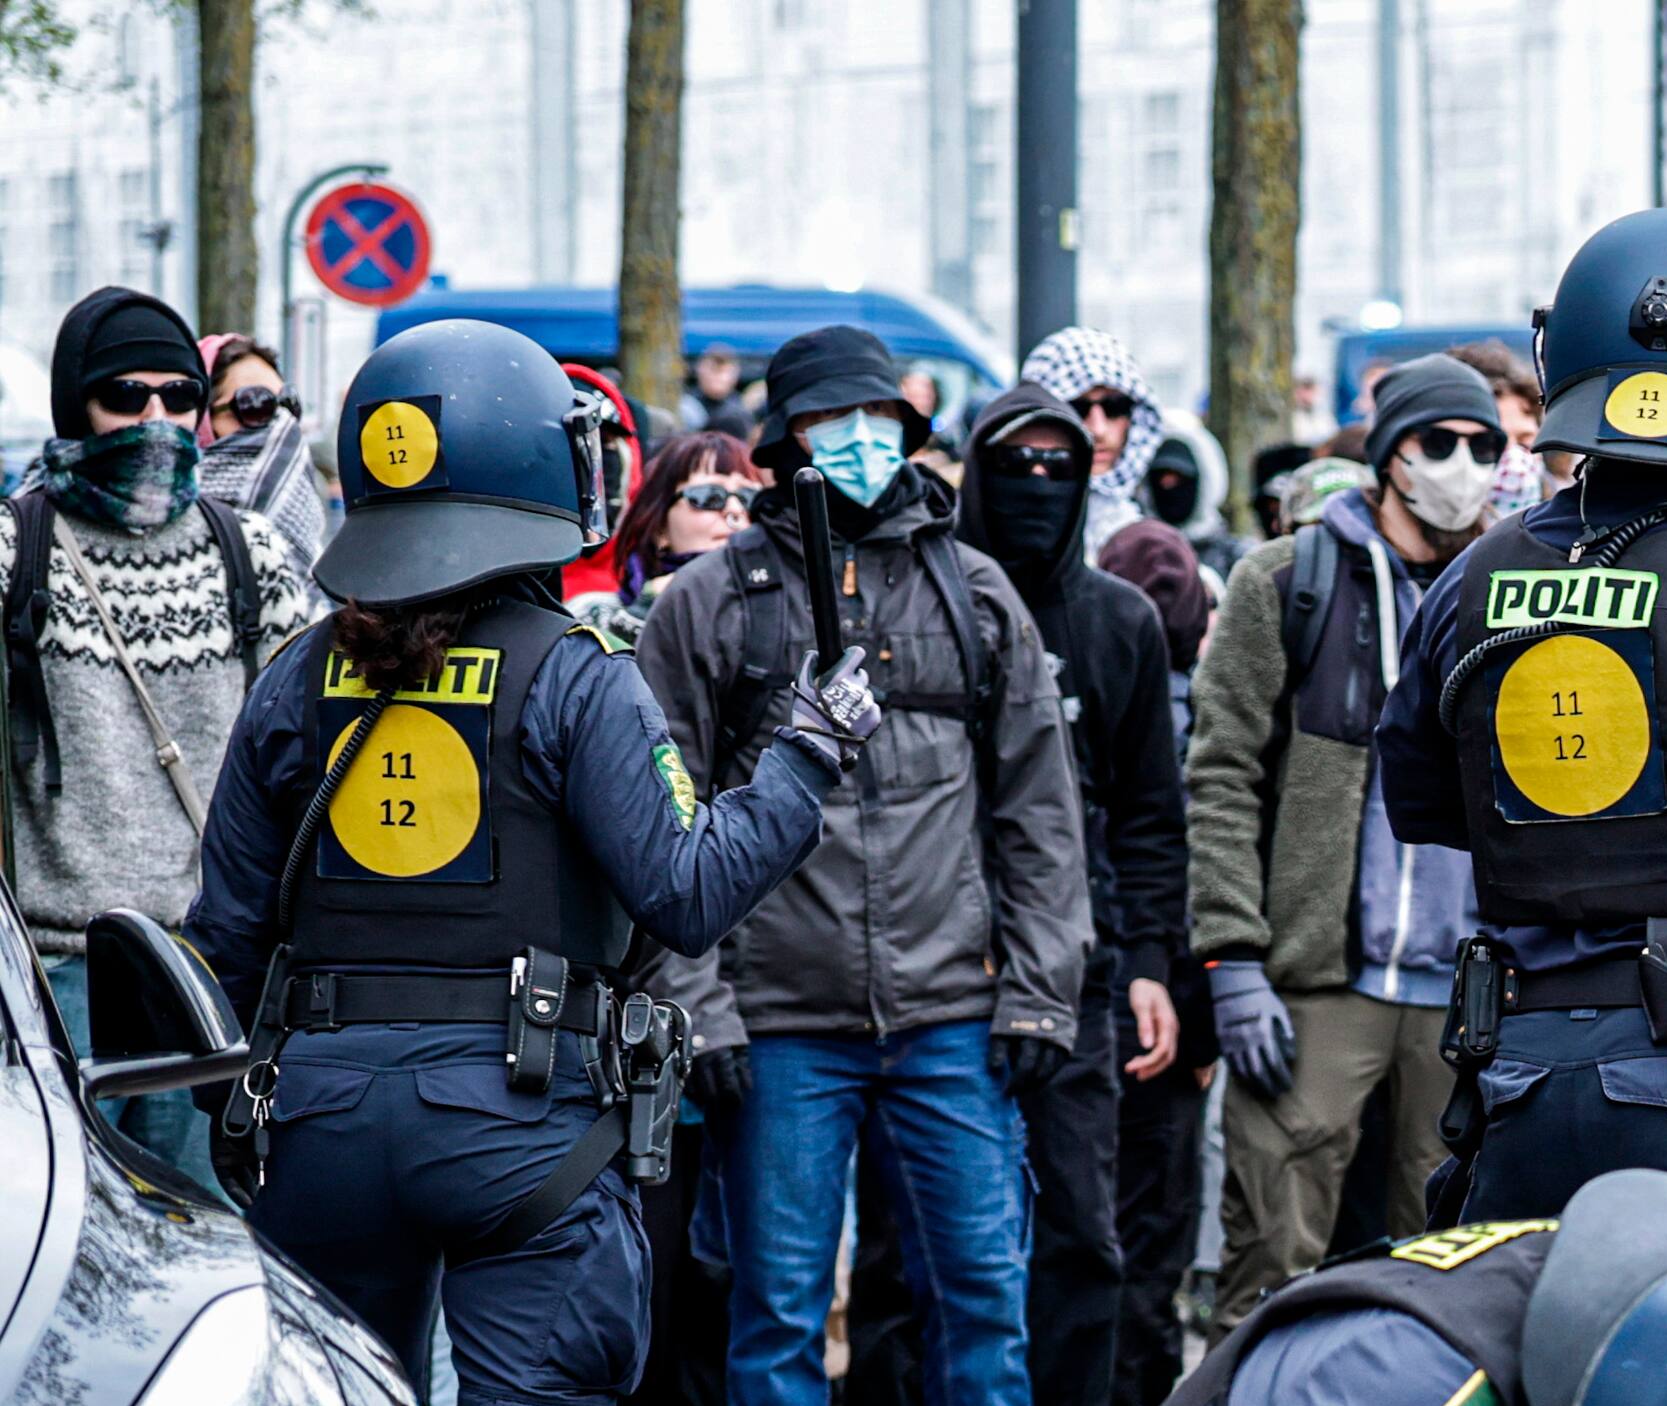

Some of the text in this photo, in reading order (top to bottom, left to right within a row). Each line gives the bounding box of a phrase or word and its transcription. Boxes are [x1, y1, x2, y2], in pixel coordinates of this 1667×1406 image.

[1639, 390, 1660, 402] 11
[1636, 408, 1658, 420] 12
[386, 425, 405, 440] 11
[388, 449, 408, 465] 12
[1492, 575, 1652, 621] POLITI
[1552, 691, 1583, 717] 11
[1553, 734, 1587, 760] 12
[381, 752, 416, 780] 11
[380, 799, 417, 827] 12
